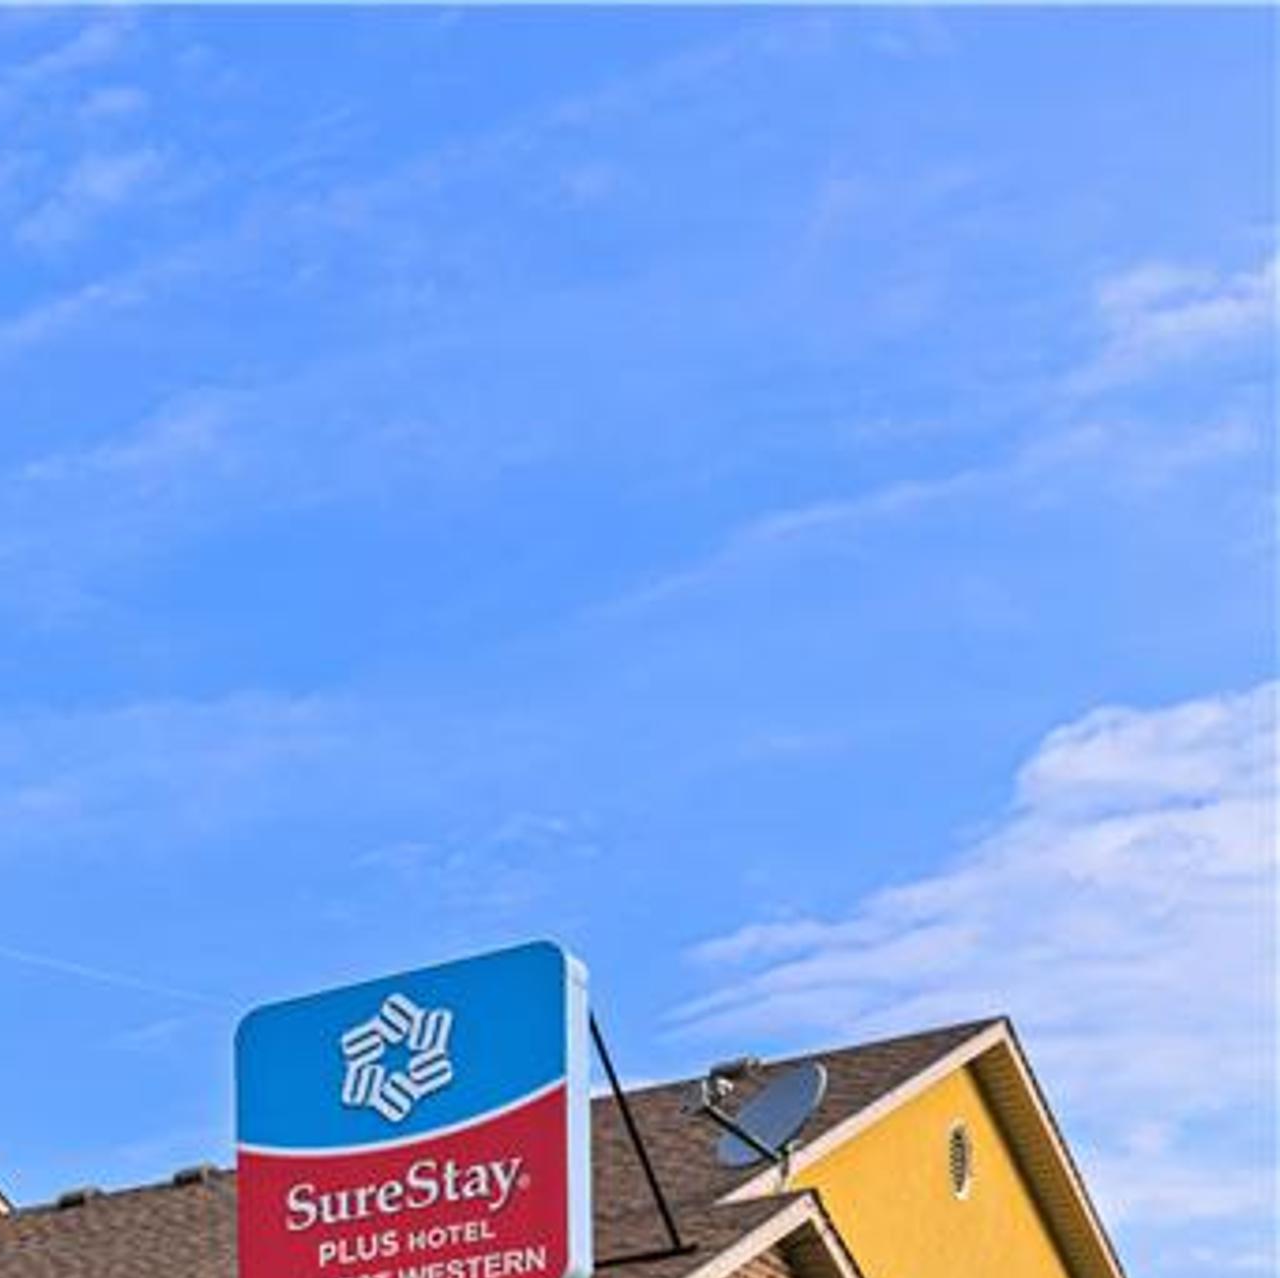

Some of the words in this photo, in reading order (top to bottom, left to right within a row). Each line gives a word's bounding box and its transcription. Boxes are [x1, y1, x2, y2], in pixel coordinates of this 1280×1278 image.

[285, 1158, 523, 1231] SureStay
[318, 1230, 400, 1268] PLUS
[408, 1220, 496, 1252] HOTEL
